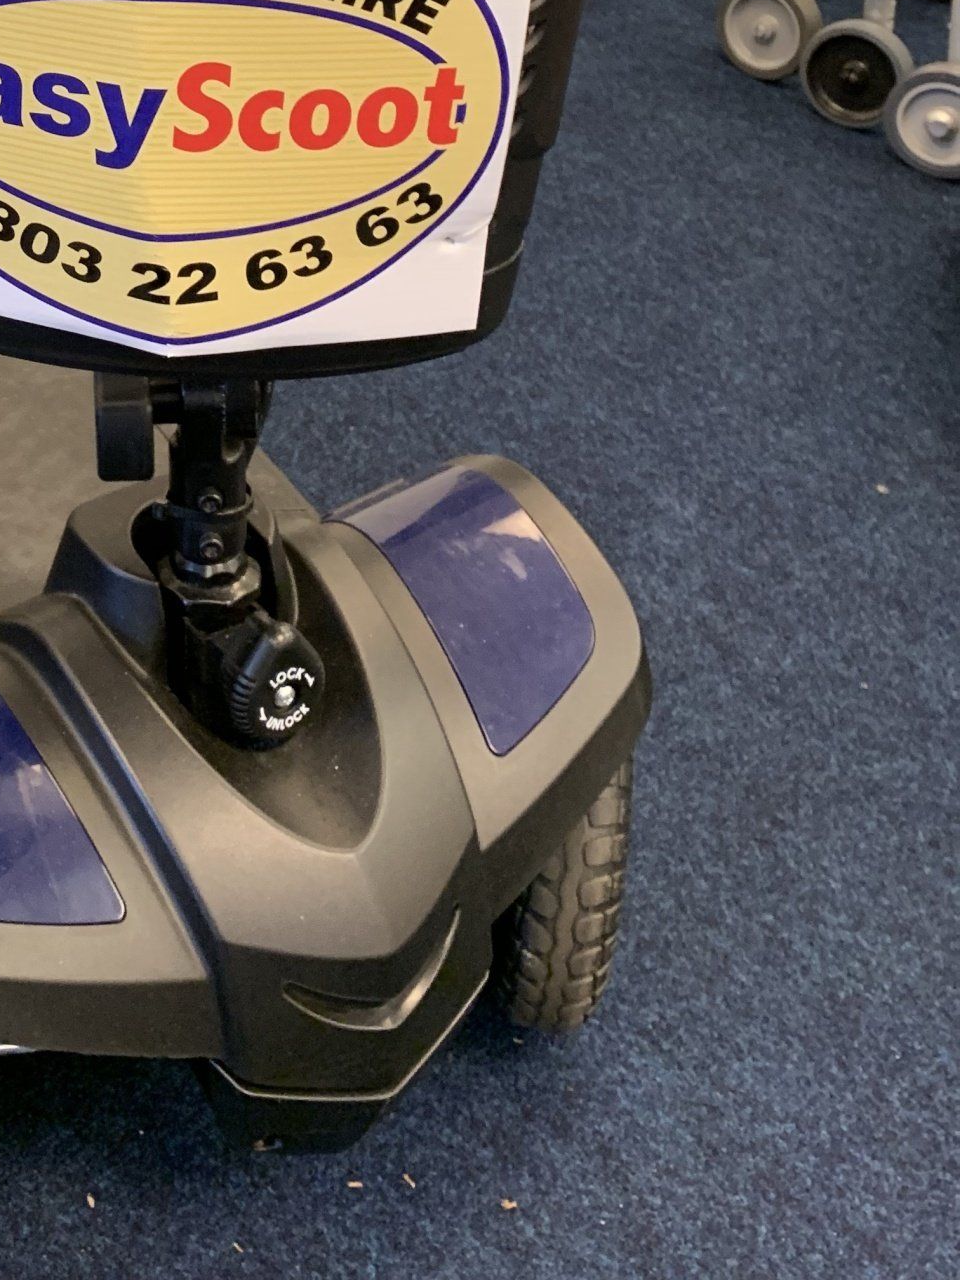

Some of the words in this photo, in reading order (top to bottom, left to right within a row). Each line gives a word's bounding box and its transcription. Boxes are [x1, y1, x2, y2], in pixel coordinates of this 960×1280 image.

[126, 261, 220, 306] 22
[244, 234, 335, 292] 63
[353, 180, 445, 249] 63
[269, 666, 306, 689] LOCK
[265, 702, 311, 731] UNLOCK
